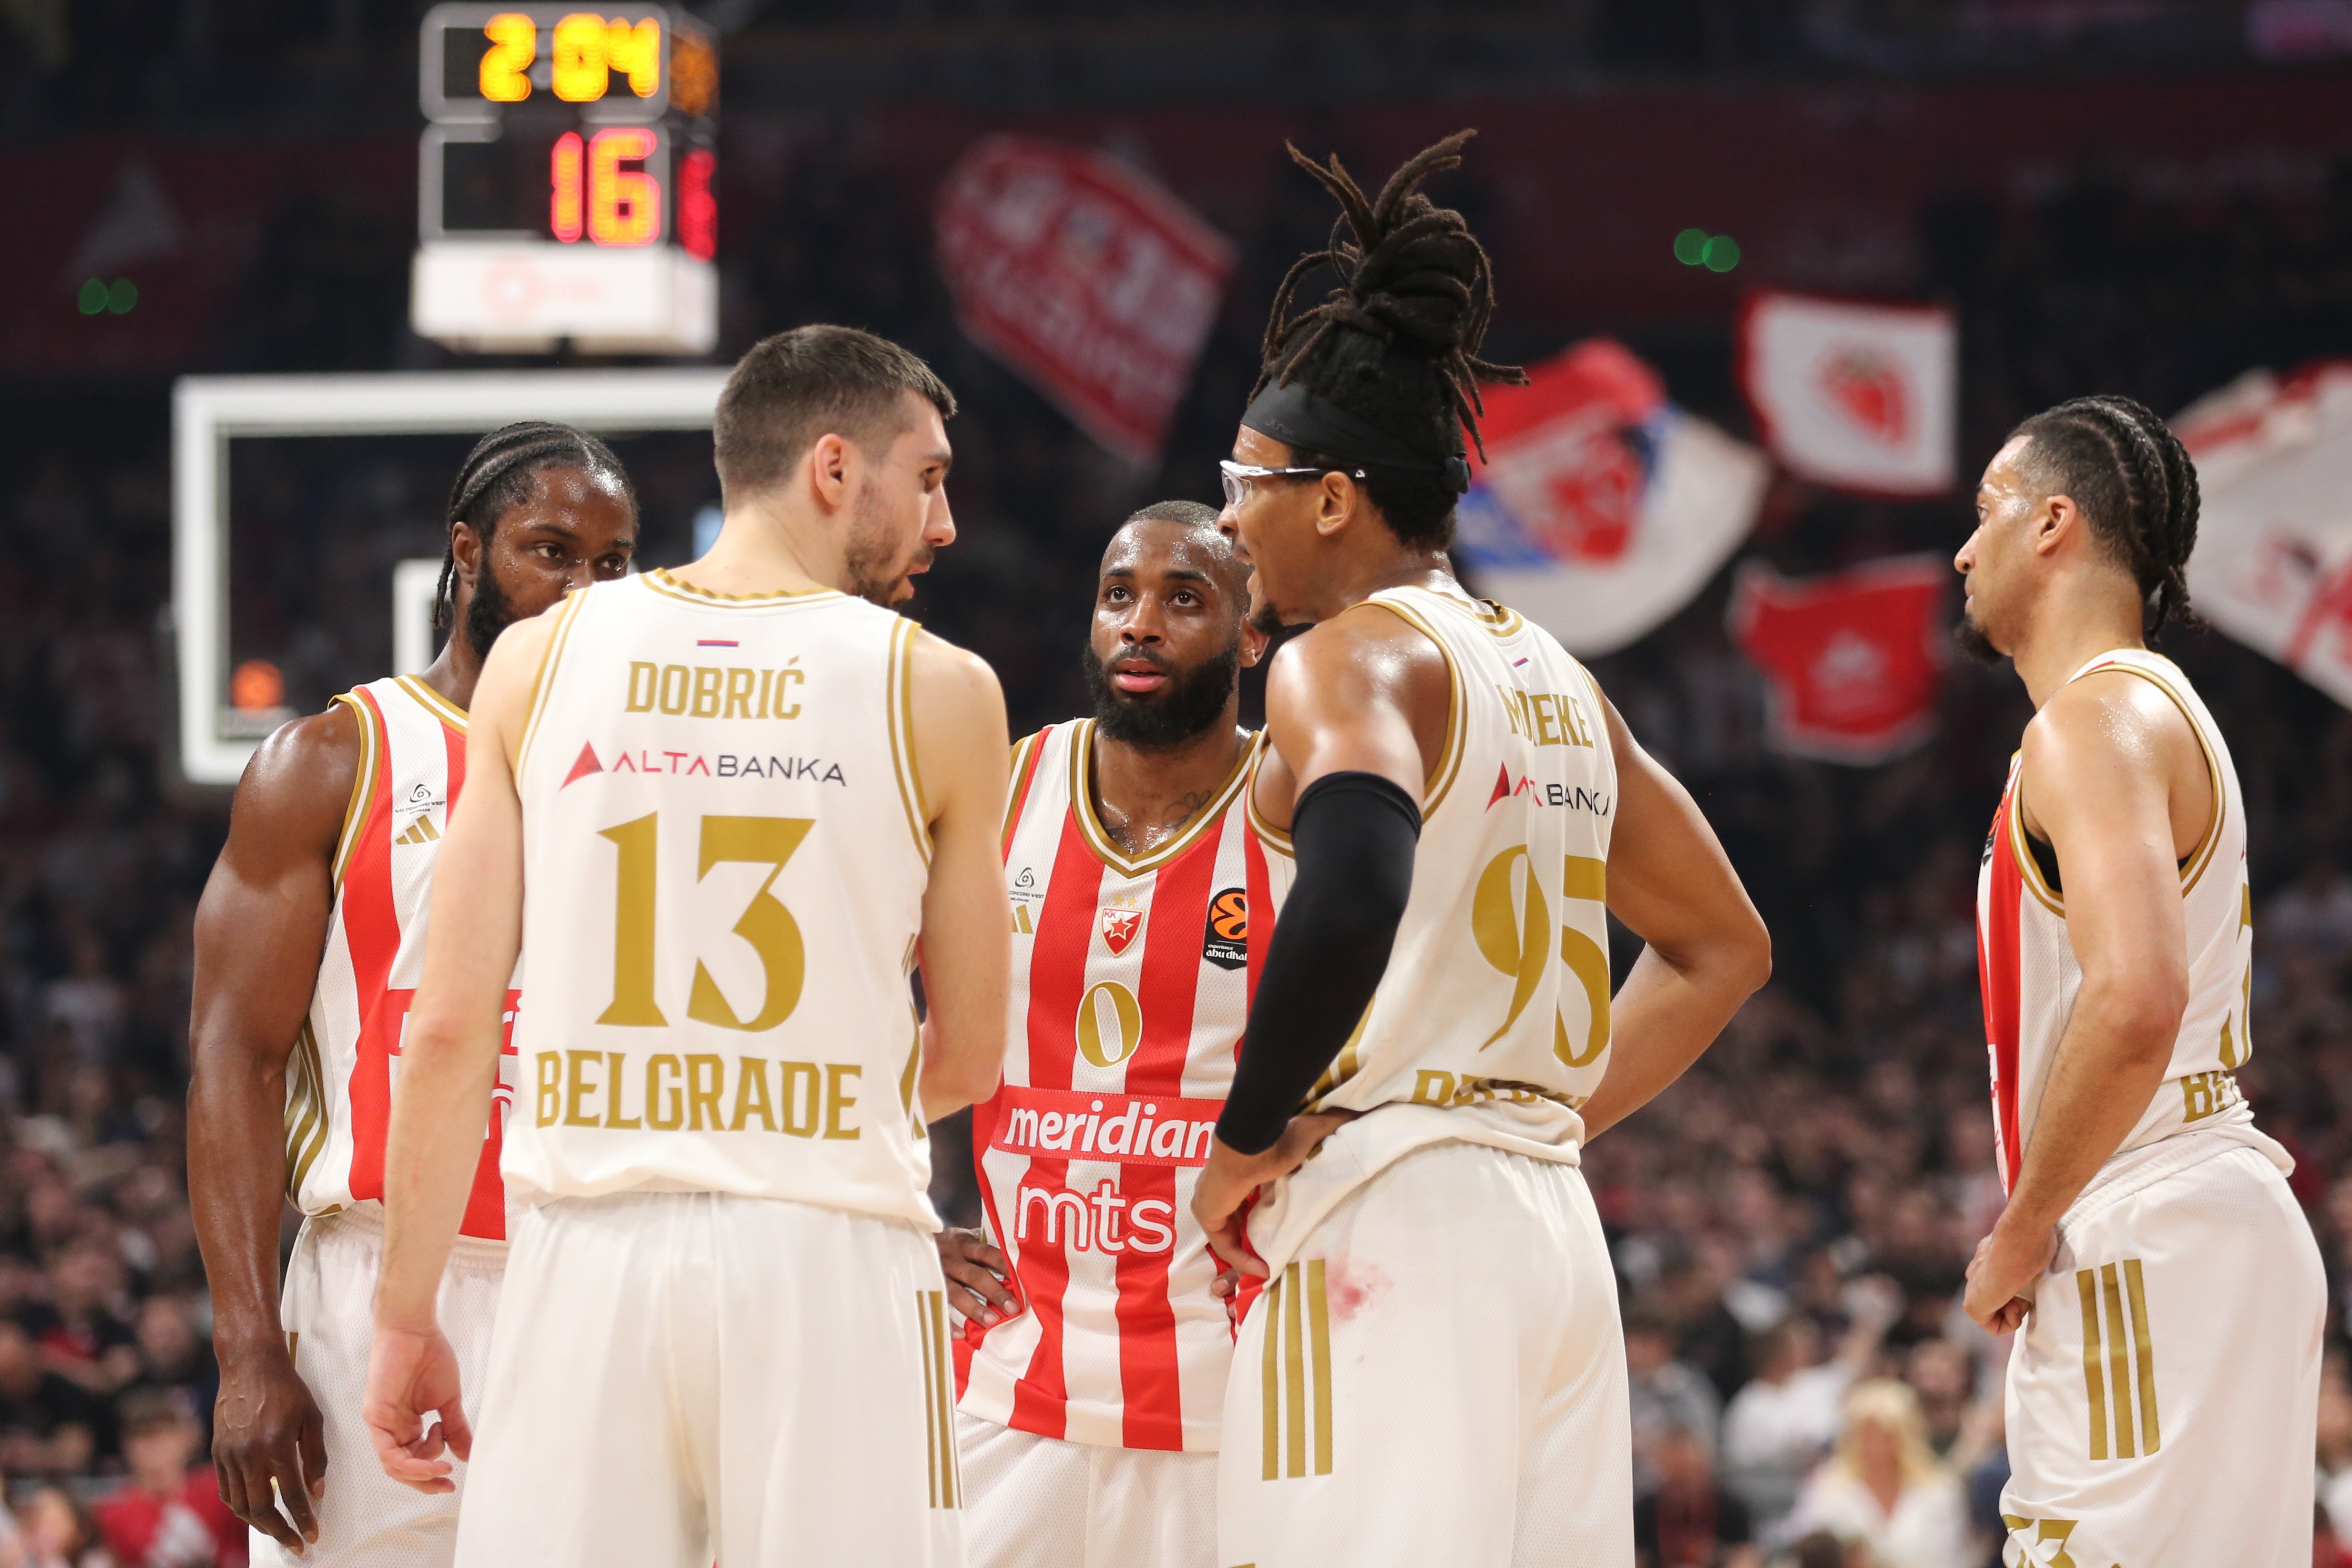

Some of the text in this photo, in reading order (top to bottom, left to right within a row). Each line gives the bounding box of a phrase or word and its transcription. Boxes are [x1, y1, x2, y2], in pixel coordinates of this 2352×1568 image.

[552, 128, 660, 247] 16
[625, 656, 805, 719] DOBRIĆ
[594, 811, 816, 1032] 13
[1104, 909, 1117, 918] KK
[1206, 949, 1225, 958] abu
[1472, 844, 1611, 1068] 95
[1075, 980, 1143, 1069] 0
[535, 1049, 861, 1140] BELGRADE
[1017, 1183, 1174, 1253] mts
